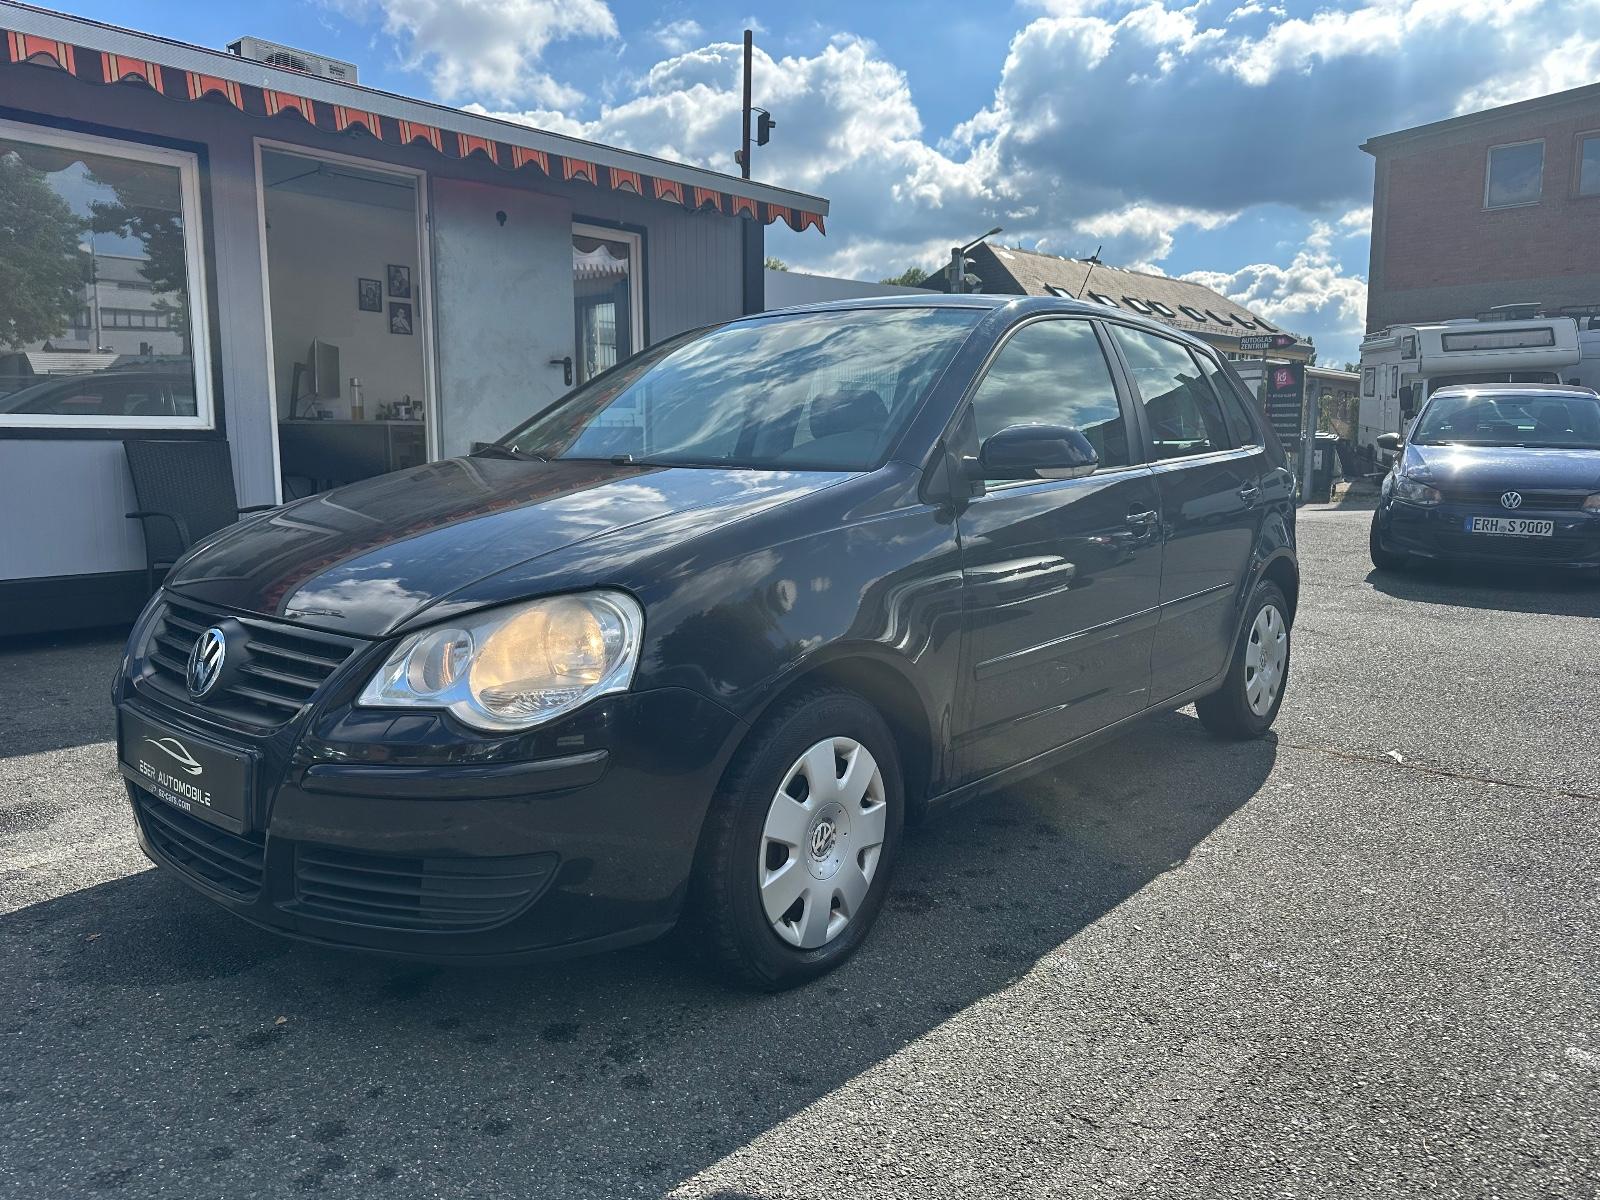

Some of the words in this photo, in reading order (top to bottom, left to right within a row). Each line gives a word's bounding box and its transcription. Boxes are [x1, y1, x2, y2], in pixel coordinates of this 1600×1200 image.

[1473, 518, 1499, 532] ERH
[1507, 520, 1516, 533] S
[1519, 521, 1552, 534] 9009
[139, 759, 156, 780] ESER
[157, 770, 211, 807] AUTOMOBILE
